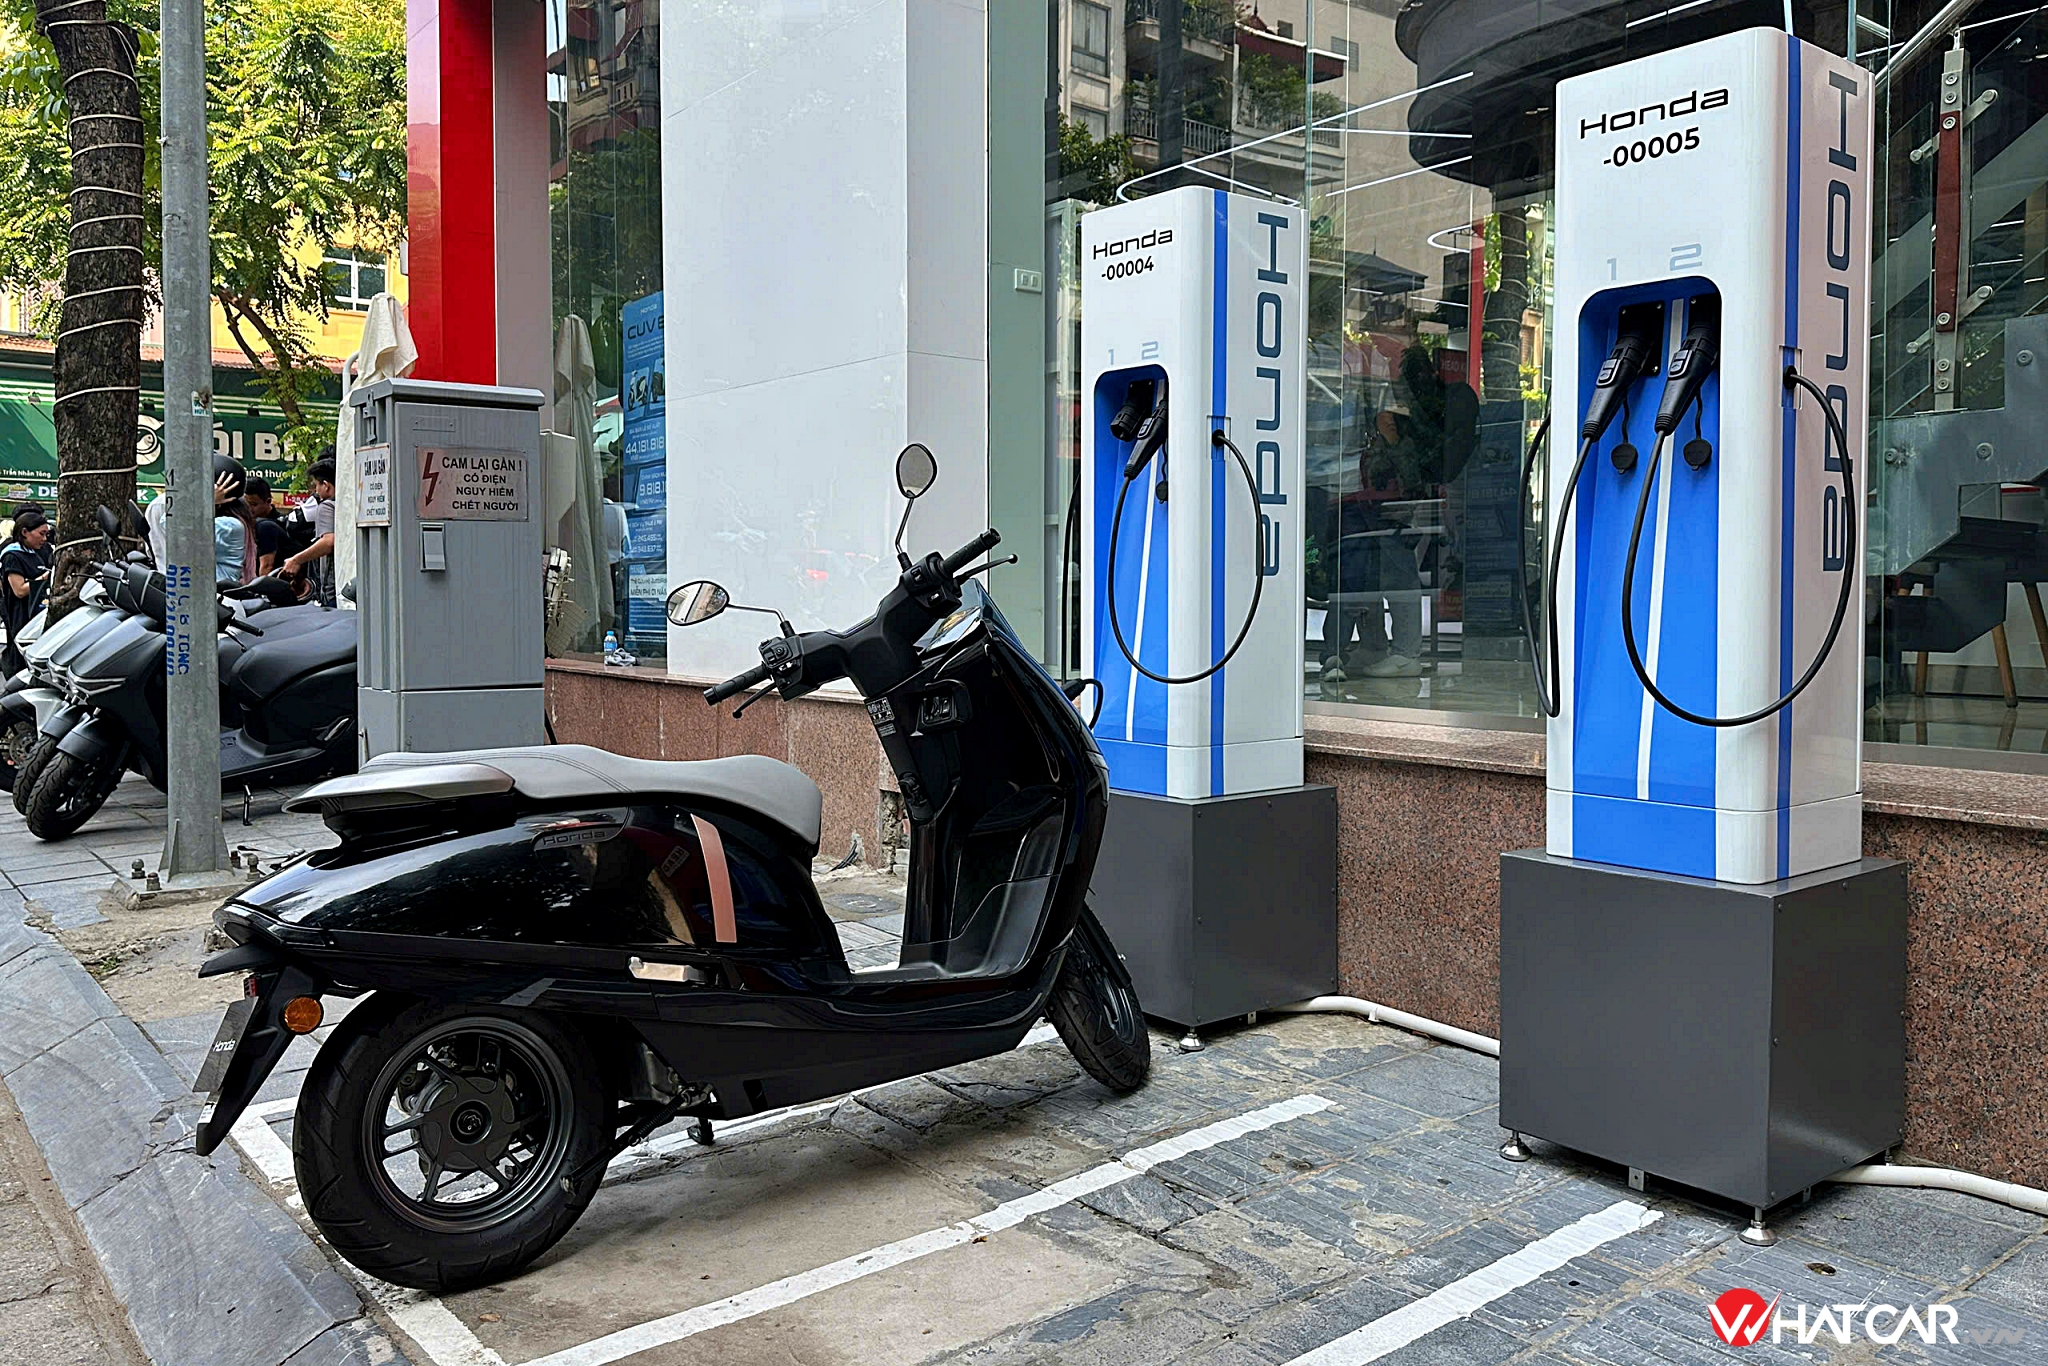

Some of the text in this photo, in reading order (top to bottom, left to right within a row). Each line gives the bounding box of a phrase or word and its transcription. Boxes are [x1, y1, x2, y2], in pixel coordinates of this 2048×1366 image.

[1580, 88, 1728, 139] Honda
[1603, 126, 1700, 167] -00005
[1093, 229, 1173, 260] Honda
[1102, 256, 1154, 280] -00004
[1607, 243, 1702, 281] 1 2
[1823, 70, 1857, 572] Honda
[1108, 341, 1159, 365] 1 2
[1256, 211, 1289, 576] Honda
[471, 458, 488, 472] LẠI
[464, 473, 480, 482] CÓ
[456, 486, 486, 496] NGUY
[543, 830, 606, 846] Honda
[213, 1039, 236, 1052] Honda
